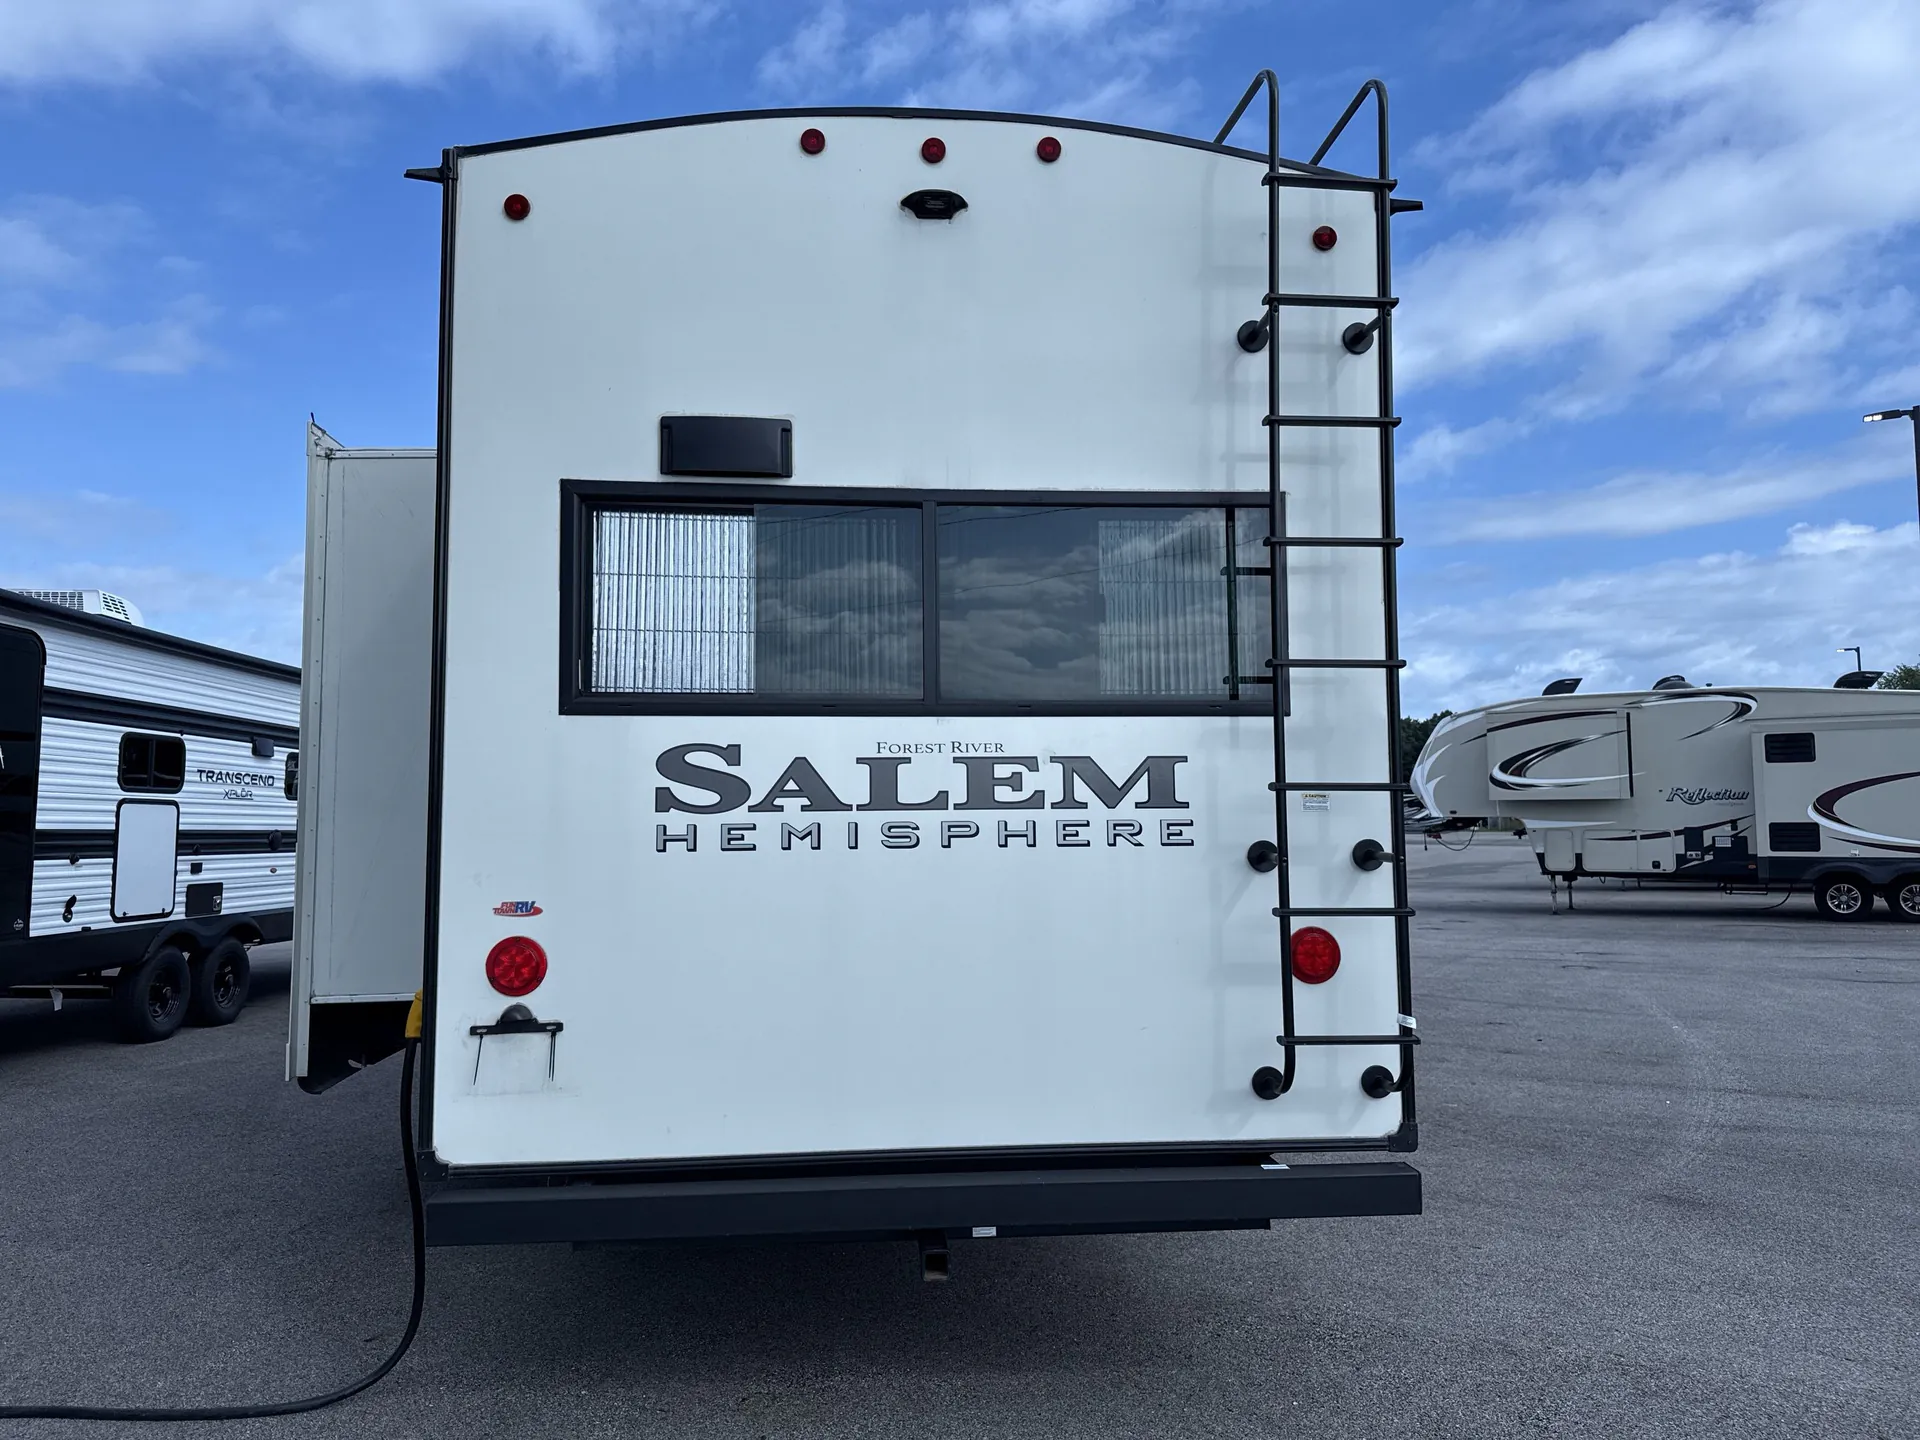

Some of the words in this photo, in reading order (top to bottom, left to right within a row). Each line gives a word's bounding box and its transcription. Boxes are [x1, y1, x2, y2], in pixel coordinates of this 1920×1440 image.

[876, 741, 946, 754] FOREST
[950, 741, 1005, 753] RIVER
[196, 769, 275, 787] TRANSCEND
[655, 743, 1190, 814] SALEM
[1666, 787, 1750, 806] Reflection
[655, 818, 1195, 852] HEMISPHERE
[515, 900, 536, 913] RV
